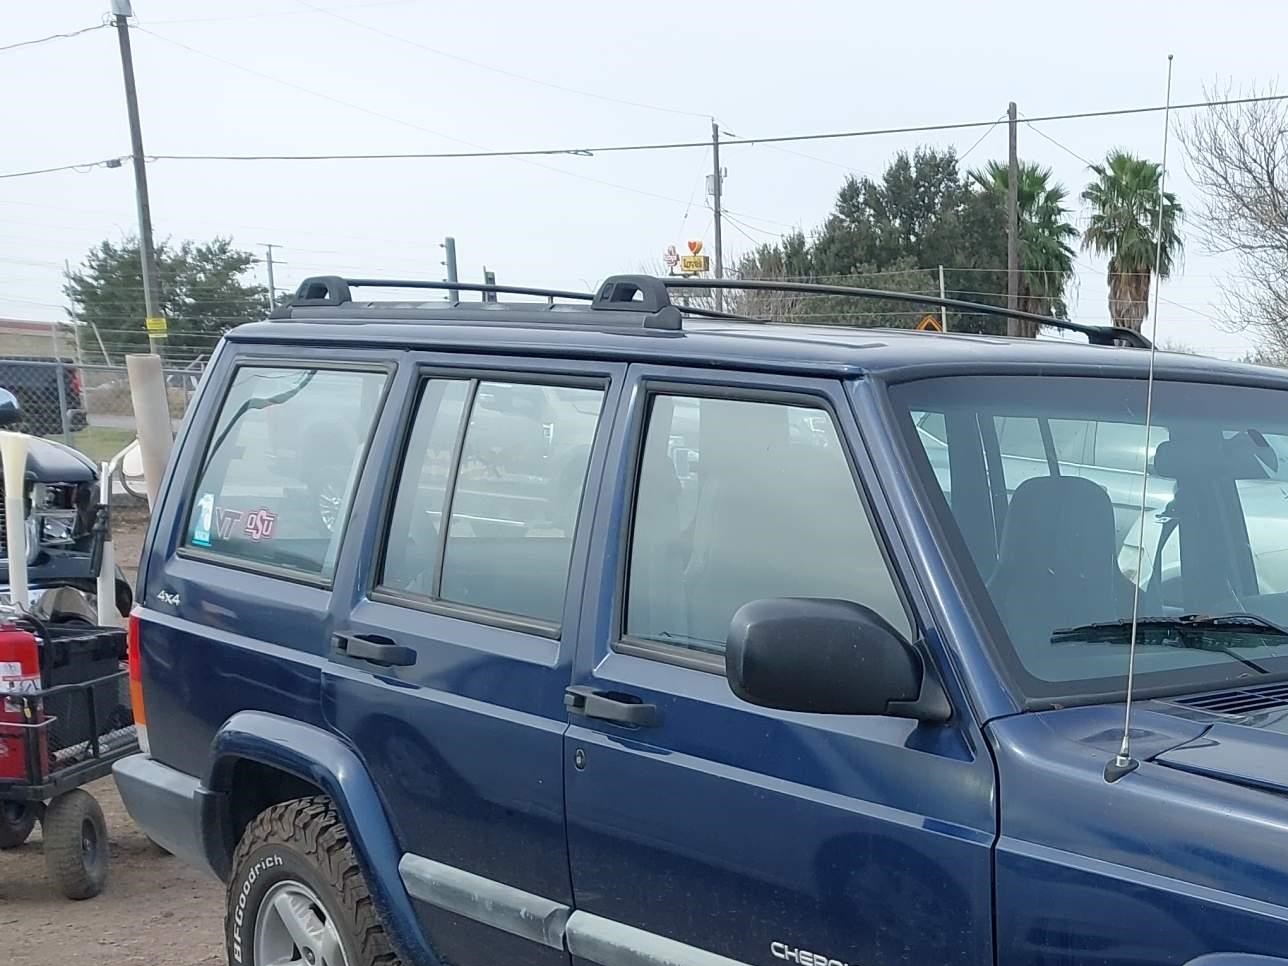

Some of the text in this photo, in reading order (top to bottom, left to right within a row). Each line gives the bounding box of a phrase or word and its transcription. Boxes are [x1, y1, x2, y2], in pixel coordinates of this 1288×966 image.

[245, 508, 279, 542] OSU
[157, 589, 181, 606] 4x4
[232, 853, 284, 964] BFGoodrich
